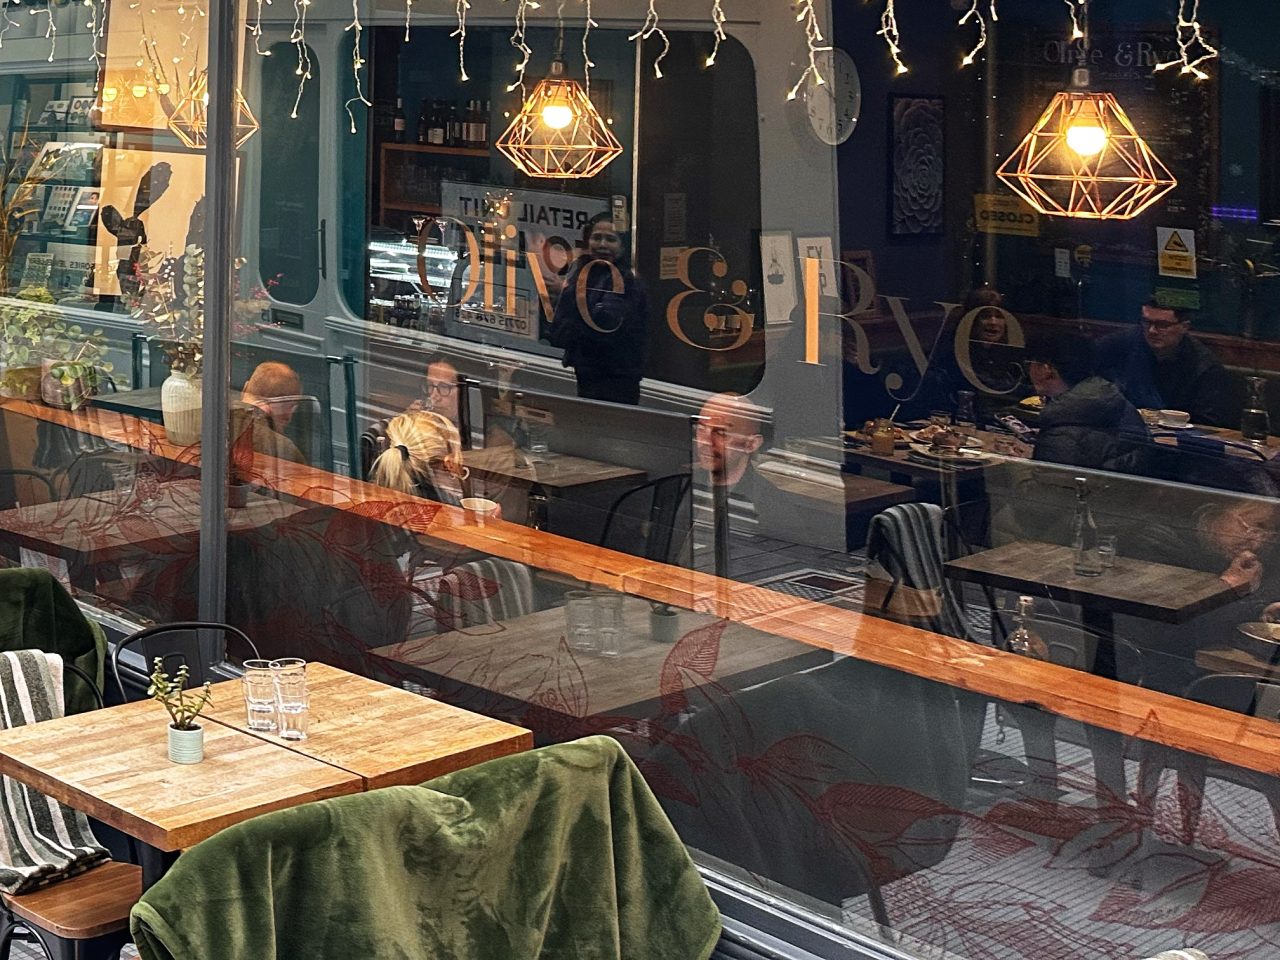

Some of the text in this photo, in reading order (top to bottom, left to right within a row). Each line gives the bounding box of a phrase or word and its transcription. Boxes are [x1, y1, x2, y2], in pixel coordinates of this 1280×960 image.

[416, 216, 1026, 403] Olive & Rye
